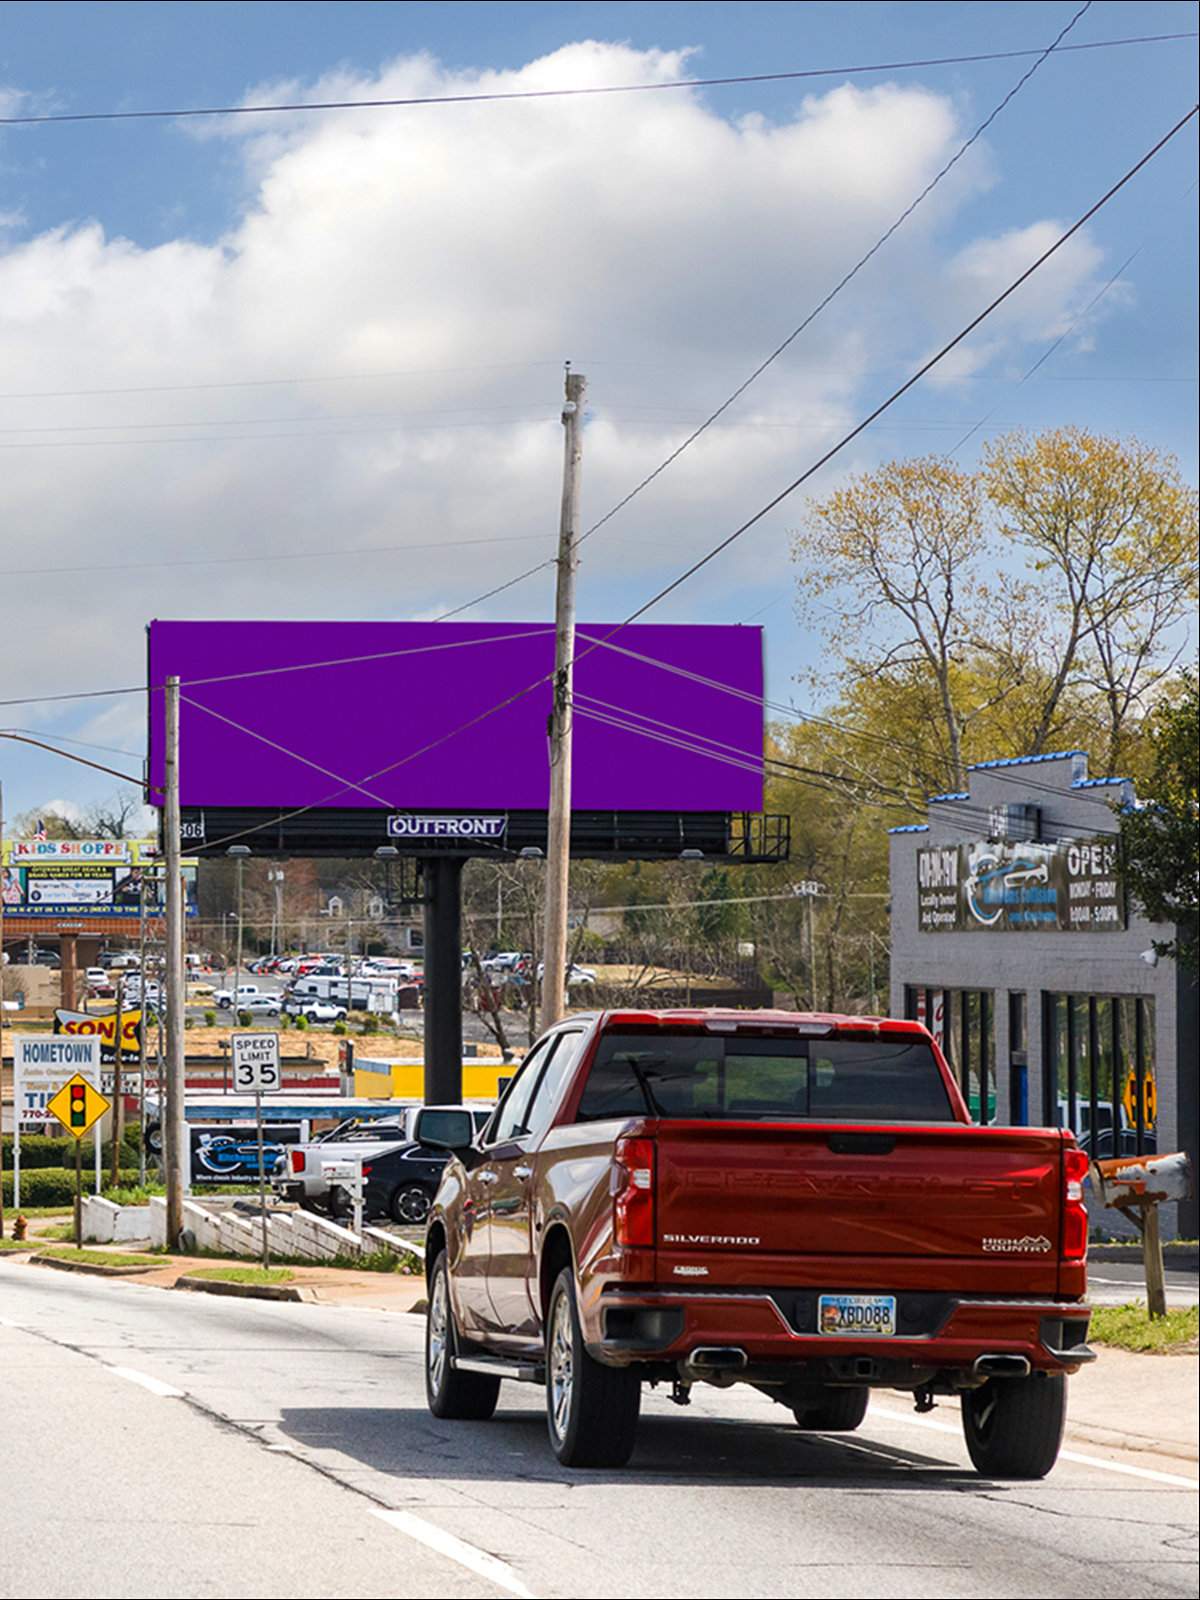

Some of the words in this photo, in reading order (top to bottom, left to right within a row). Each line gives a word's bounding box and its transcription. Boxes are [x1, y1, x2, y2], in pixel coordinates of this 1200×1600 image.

[392, 819, 501, 834] OUTFRONT
[18, 844, 57, 854] KIDS
[60, 843, 123, 855] SHOPPE
[65, 1021, 137, 1039] SONC
[236, 1039, 276, 1050] SPEED
[23, 1043, 92, 1062] HOMETOWN
[103, 1054, 139, 1062] Drie-In
[240, 1051, 271, 1061] LIMIT
[238, 1064, 277, 1085] 35
[663, 1234, 760, 1245] SILVERADO
[982, 1245, 1050, 1253] COUNTRY
[840, 1306, 890, 1324] XBD088
